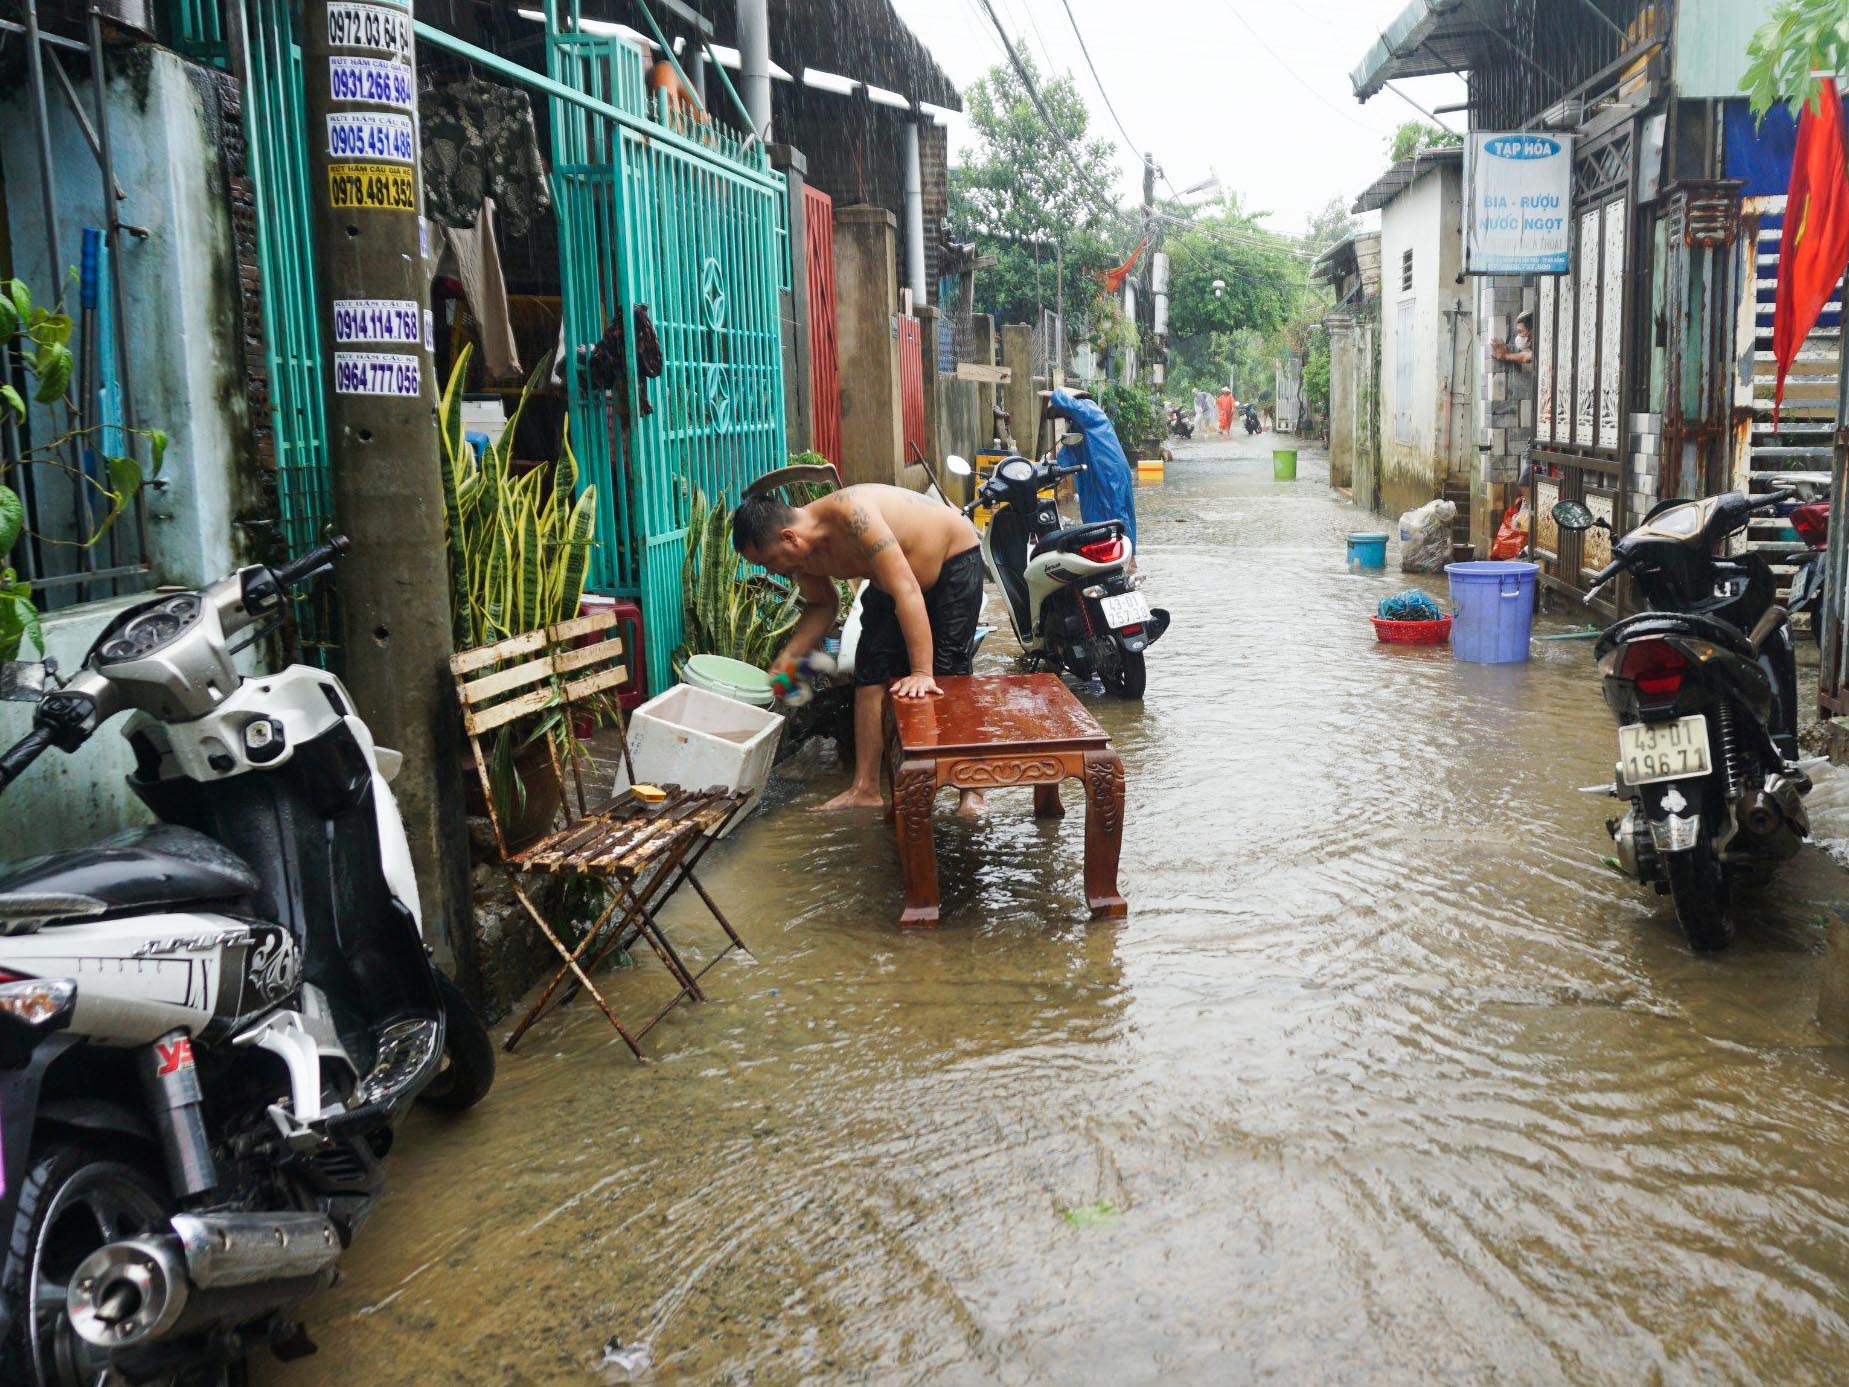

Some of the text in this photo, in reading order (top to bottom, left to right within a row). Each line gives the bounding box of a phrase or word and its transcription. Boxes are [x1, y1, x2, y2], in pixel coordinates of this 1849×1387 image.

[332, 69, 411, 105] 0931.266.984
[332, 125, 411, 159] 0905.451.486
[1494, 139, 1551, 159] TẠP HÓA
[332, 176, 413, 208] 0978.481.352
[1484, 196, 1507, 208] BIA
[1520, 194, 1559, 211] RƯỢU
[1524, 218, 1563, 233] NGỌT
[336, 309, 417, 340] 0914.114.768
[337, 362, 417, 394] 0964.777.056
